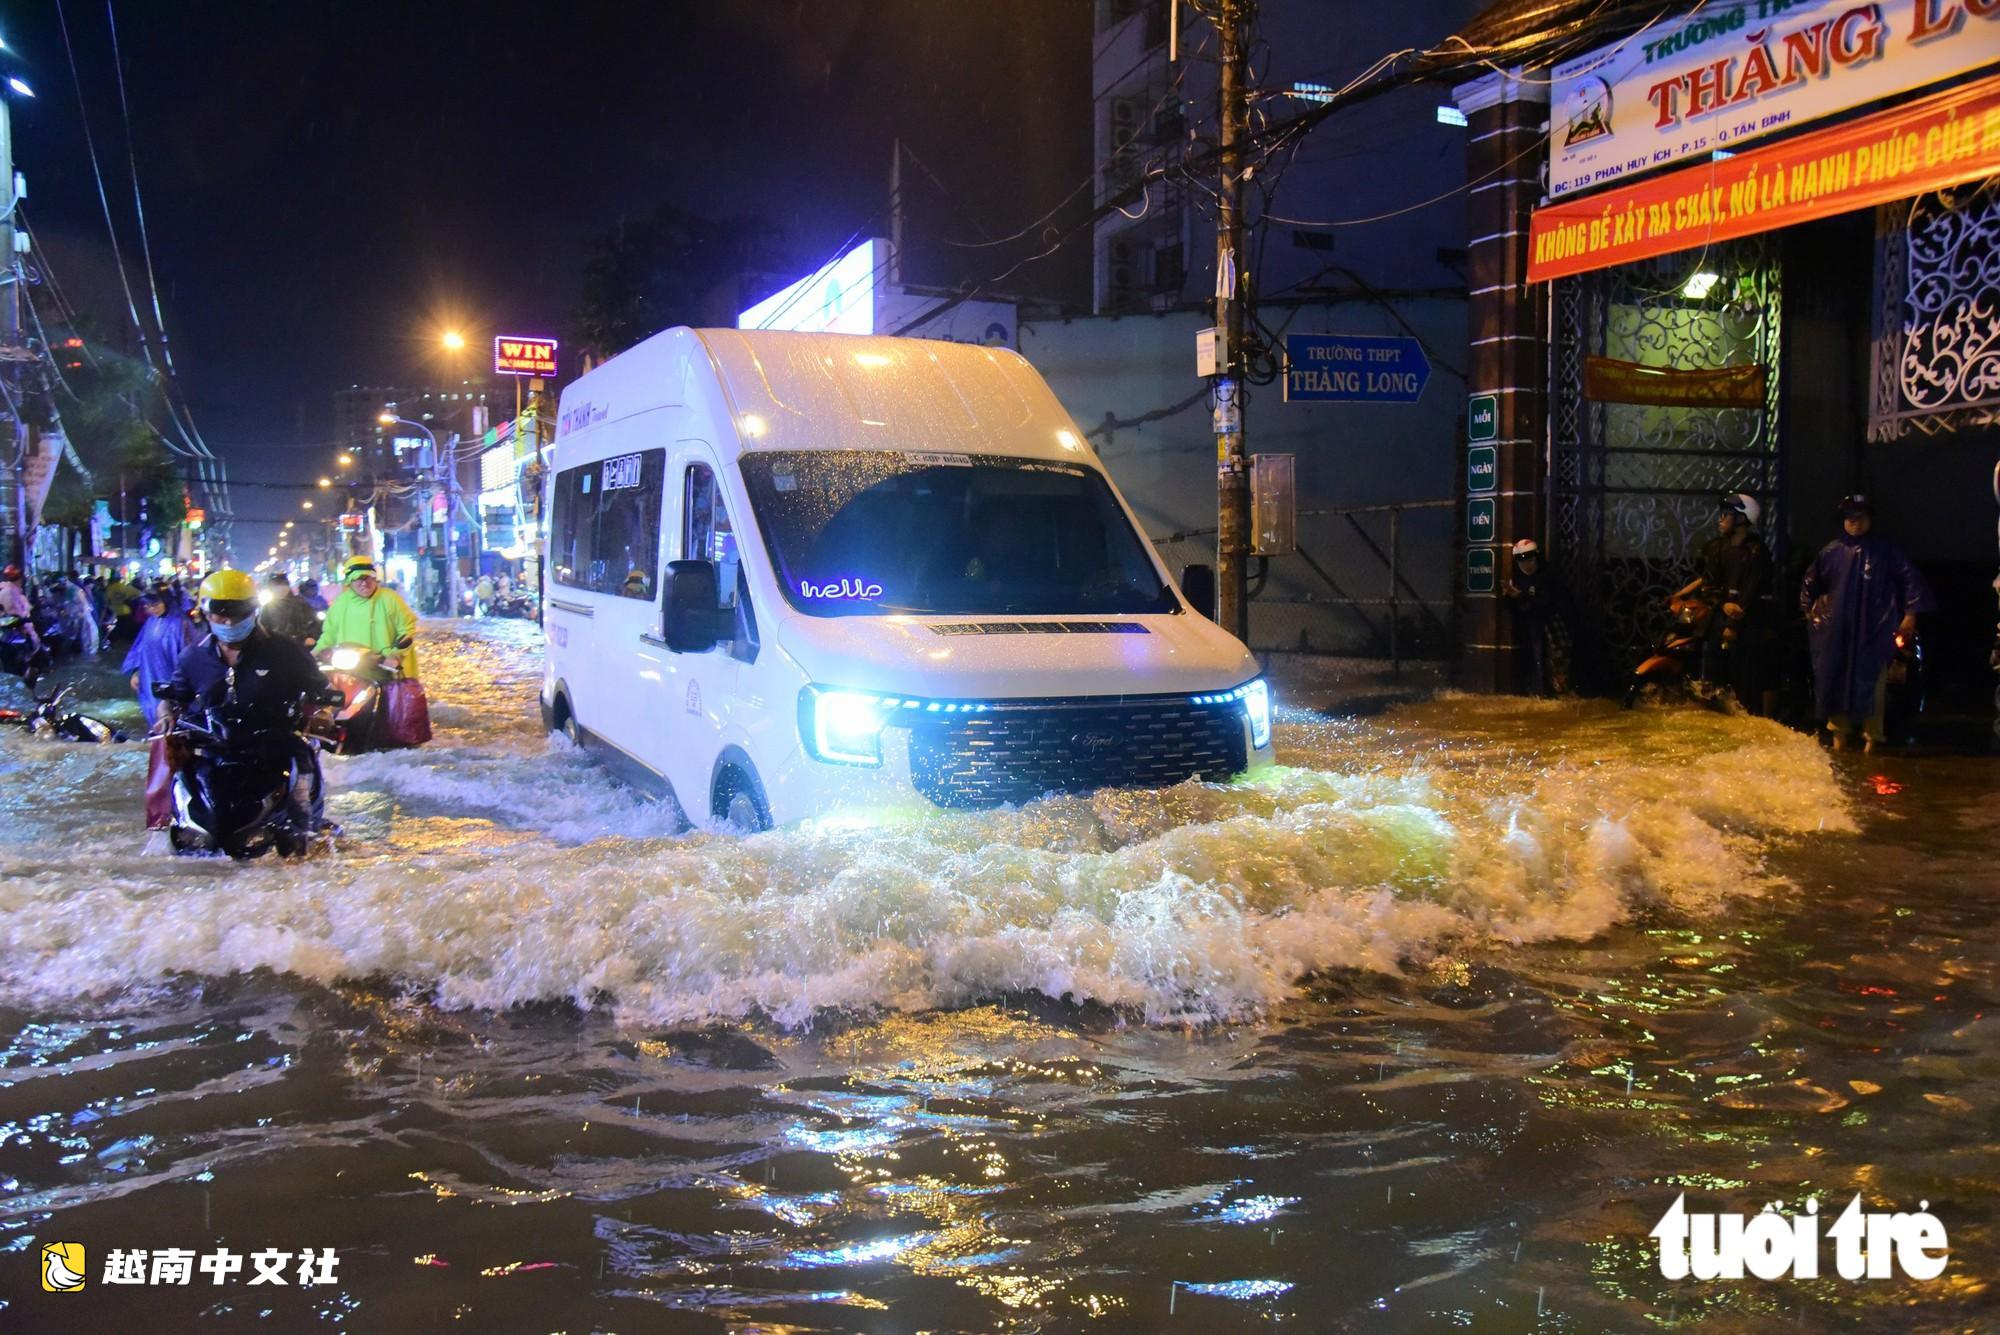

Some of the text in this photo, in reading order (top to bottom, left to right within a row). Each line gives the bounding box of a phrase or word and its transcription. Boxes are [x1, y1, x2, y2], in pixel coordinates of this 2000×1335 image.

[1648, 0, 2000, 129] THĂNG L
[1574, 172, 1591, 188] 119
[1595, 165, 1623, 181] PHAN
[1627, 156, 1648, 171] HUY
[1653, 147, 1671, 163] ÍCH
[1733, 118, 1756, 138] TÂN
[1535, 221, 1587, 264] KHÔNG
[1589, 204, 1612, 252] ĐỂ
[1613, 200, 1645, 246] XẢY
[1648, 202, 1671, 238] RA
[1675, 183, 1727, 231] CHÁY,
[1729, 163, 1759, 218] NỔ
[1761, 162, 1786, 211] LÀ
[1790, 151, 1850, 208] HẠNH
[1854, 128, 1919, 187] PHÚC
[1924, 106, 1977, 168] CỦA
[501, 342, 552, 359] WIN
[1366, 348, 1401, 362] THPT
[1291, 366, 1418, 393] THĂNG LONG
[1471, 462, 1493, 475] NGÀY
[1472, 511, 1490, 525] ĐẾN
[801, 579, 882, 598] hello
